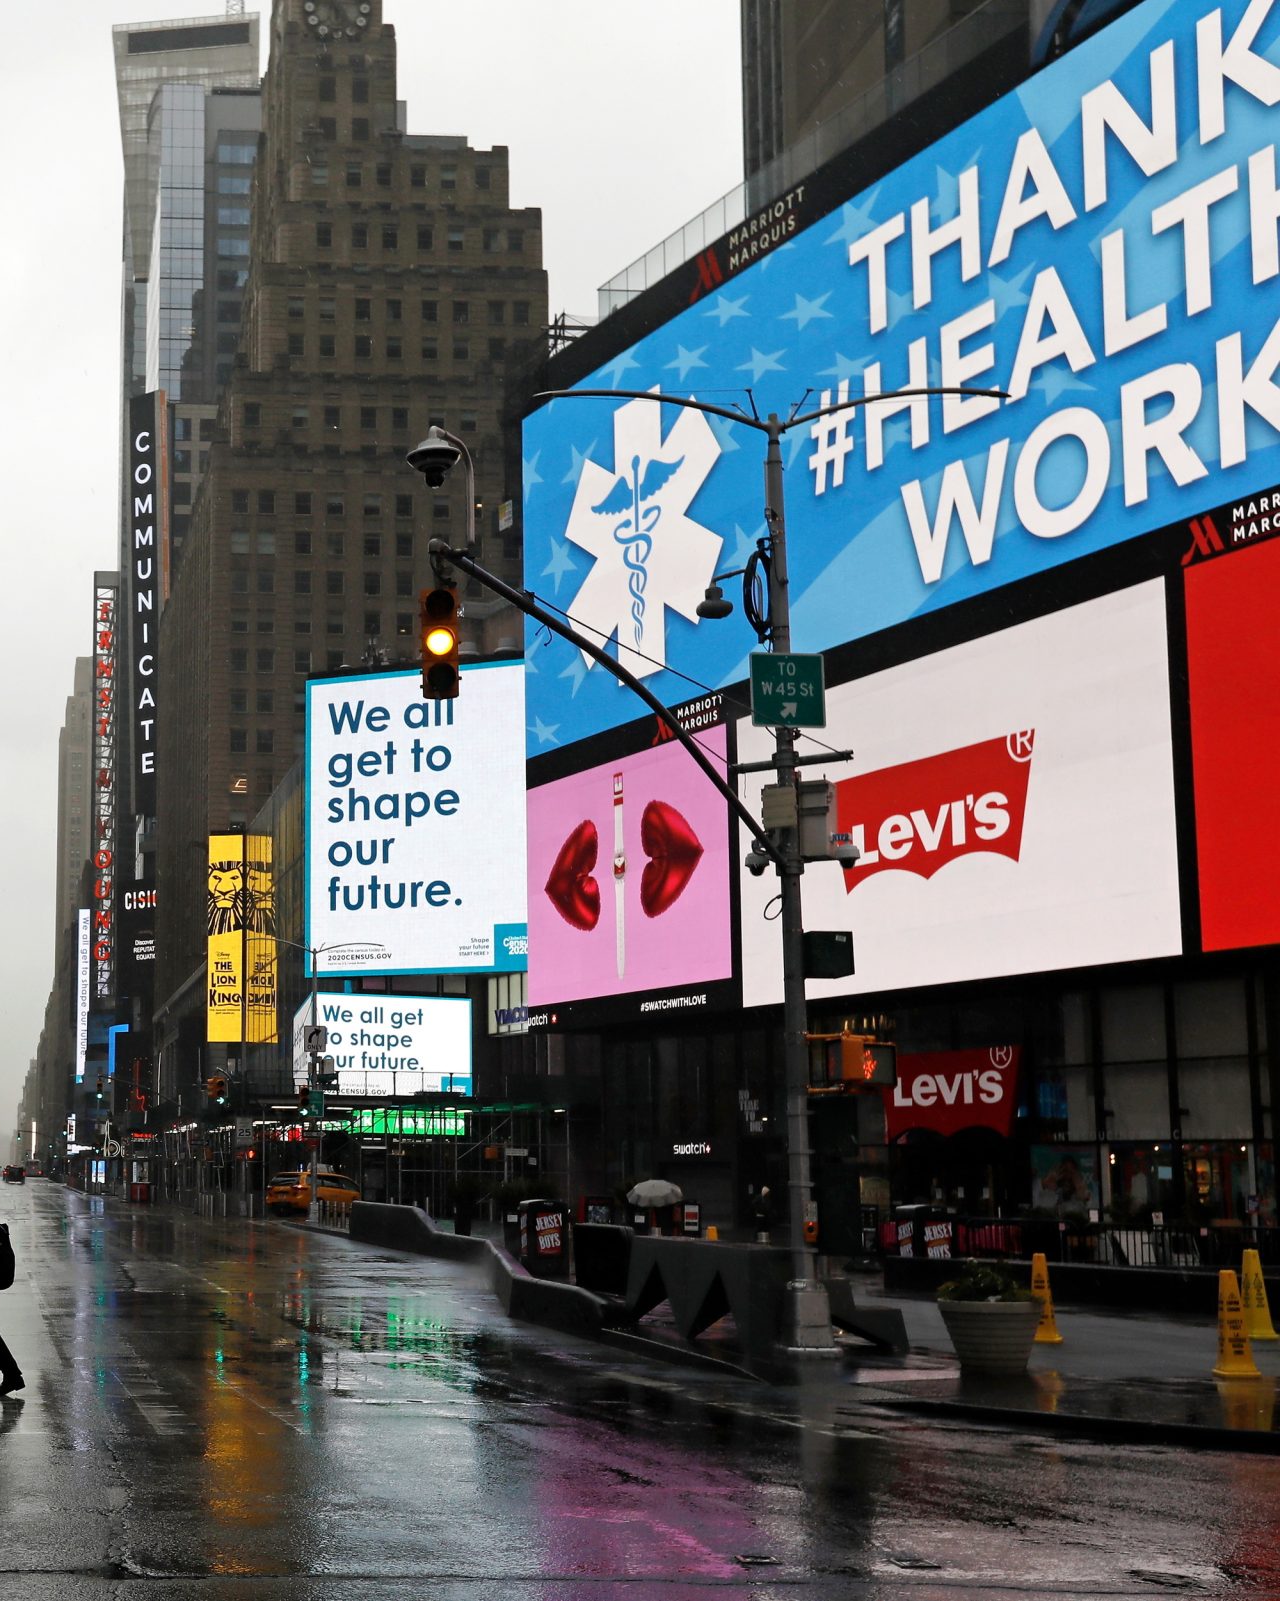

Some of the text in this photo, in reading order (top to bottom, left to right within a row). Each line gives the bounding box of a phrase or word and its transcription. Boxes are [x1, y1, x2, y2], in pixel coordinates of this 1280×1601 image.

[728, 186, 805, 250] MARRIOTT
[729, 215, 796, 271] MARQUIS
[134, 431, 155, 774] COMMUNICATE
[778, 662, 796, 676] TO
[761, 681, 814, 697] W 45 St
[328, 698, 454, 735] We all
[677, 693, 724, 719] MARRIOTT
[328, 739, 452, 787] get to
[327, 787, 460, 827] shape
[327, 837, 395, 867] our
[327, 875, 463, 911] future.
[214, 961, 233, 970] THE
[327, 953, 392, 961] 2020CENSUS.GOV
[211, 973, 236, 988] LION
[80, 979, 89, 1008] shape
[209, 988, 241, 1007] KING
[641, 994, 706, 1012] #SWATCHWITHLOVE
[322, 1005, 423, 1029] We all get
[351, 1029, 413, 1051] shape
[361, 1051, 424, 1070] future.
[238, 1128, 251, 1137] 25
[673, 1142, 706, 1155] swatch
[535, 1213, 563, 1231] JERSEY
[924, 1221, 952, 1242] JERSEY
[538, 1233, 561, 1250] BOYS
